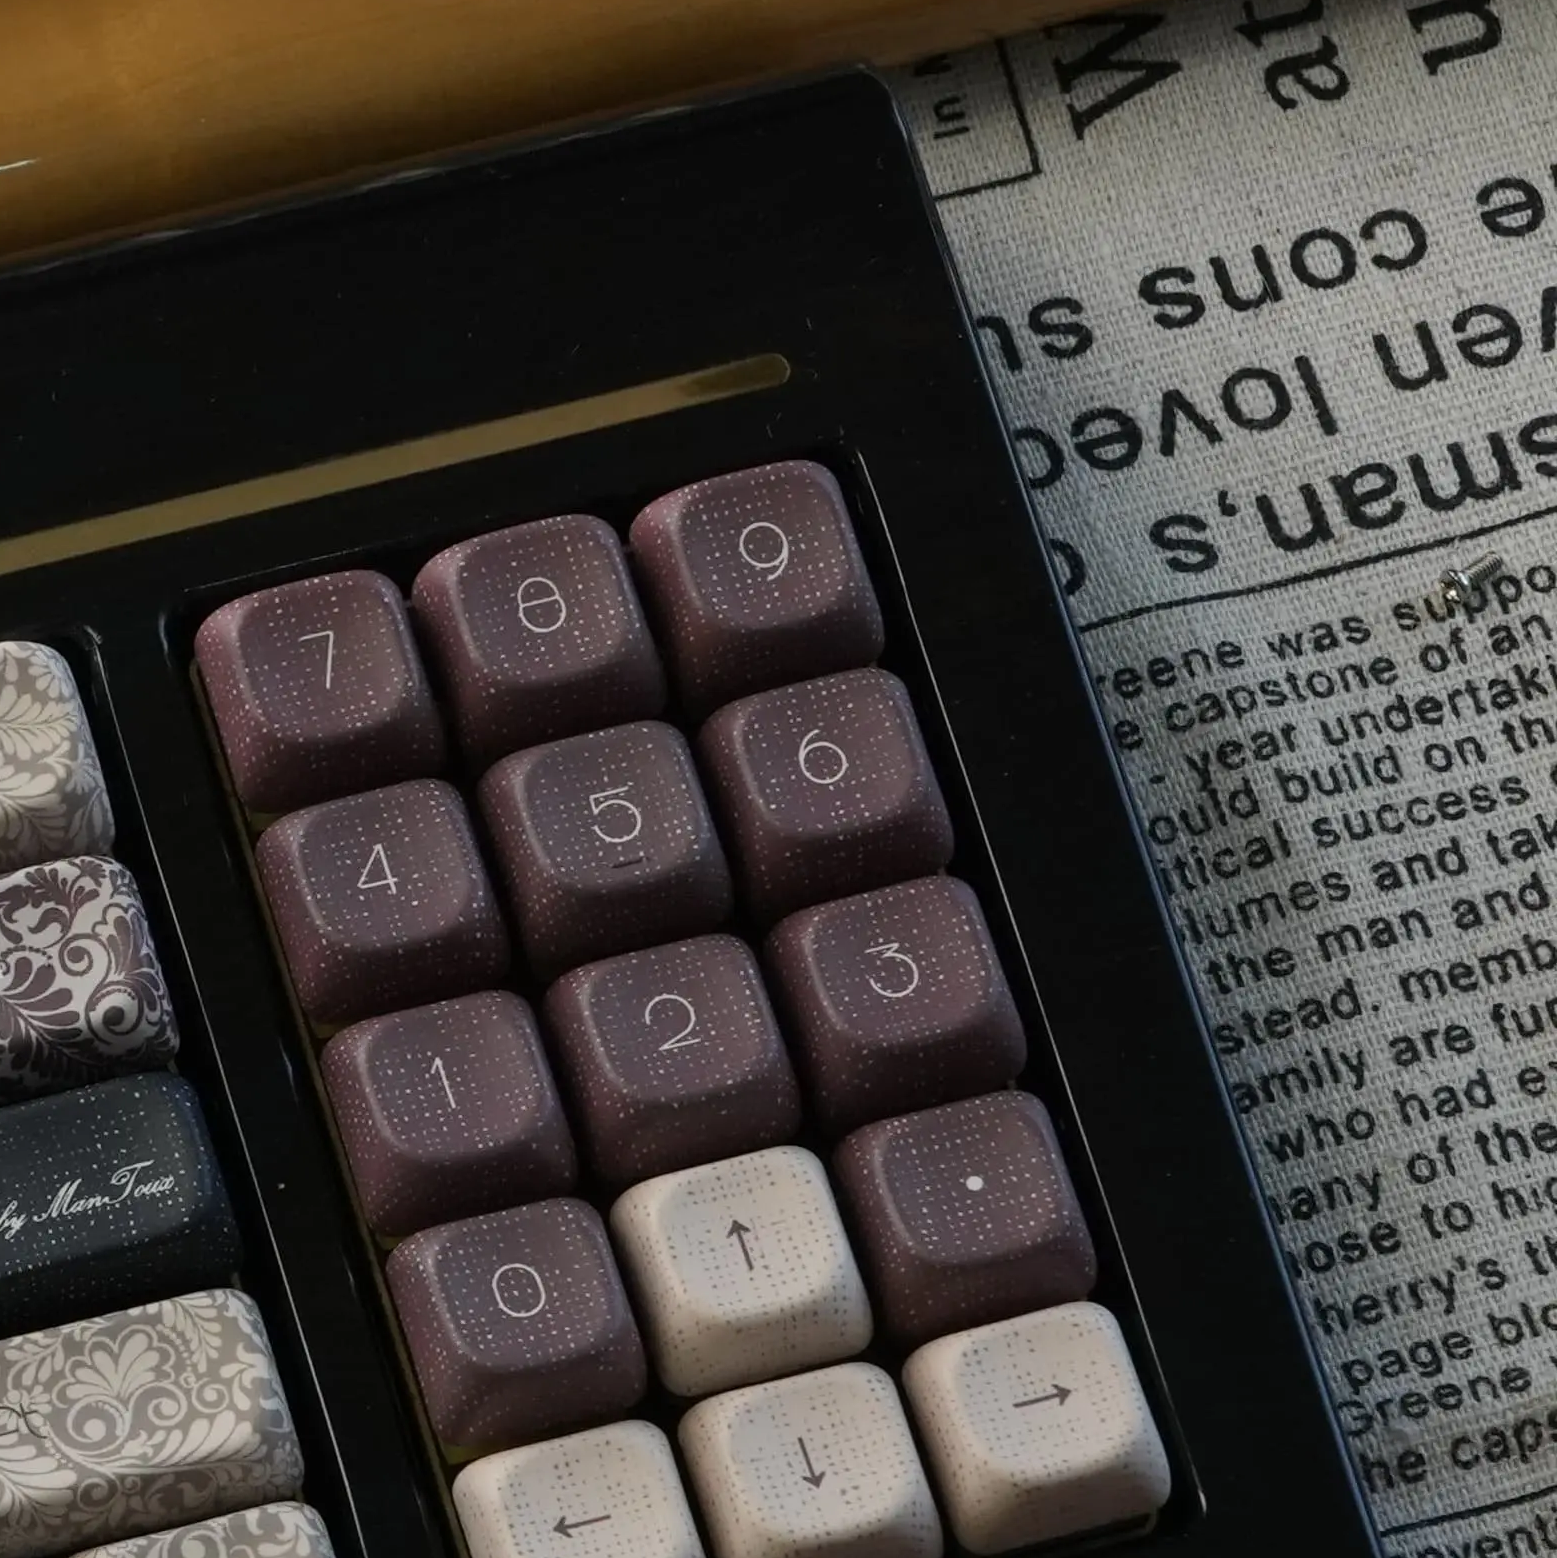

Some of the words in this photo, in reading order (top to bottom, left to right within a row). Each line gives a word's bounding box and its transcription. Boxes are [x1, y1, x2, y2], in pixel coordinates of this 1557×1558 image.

[1140, 208, 1428, 330] cons
[738, 520, 791, 581] 9
[1267, 613, 1372, 659] was
[1164, 654, 1398, 733] capstone
[1419, 629, 1467, 674] of
[1185, 724, 1296, 791] year
[1276, 745, 1404, 804] build
[1424, 733, 1486, 772] on
[1312, 773, 1531, 847] success
[355, 842, 400, 897] 4
[1371, 837, 1467, 894] and
[866, 941, 920, 999] 3
[1206, 946, 1295, 994] the
[1318, 908, 1433, 963] man
[1394, 1022, 1475, 1068] are
[1264, 1108, 1376, 1162] who
[1395, 1069, 1495, 1124] had
[1341, 1331, 1474, 1395] page
